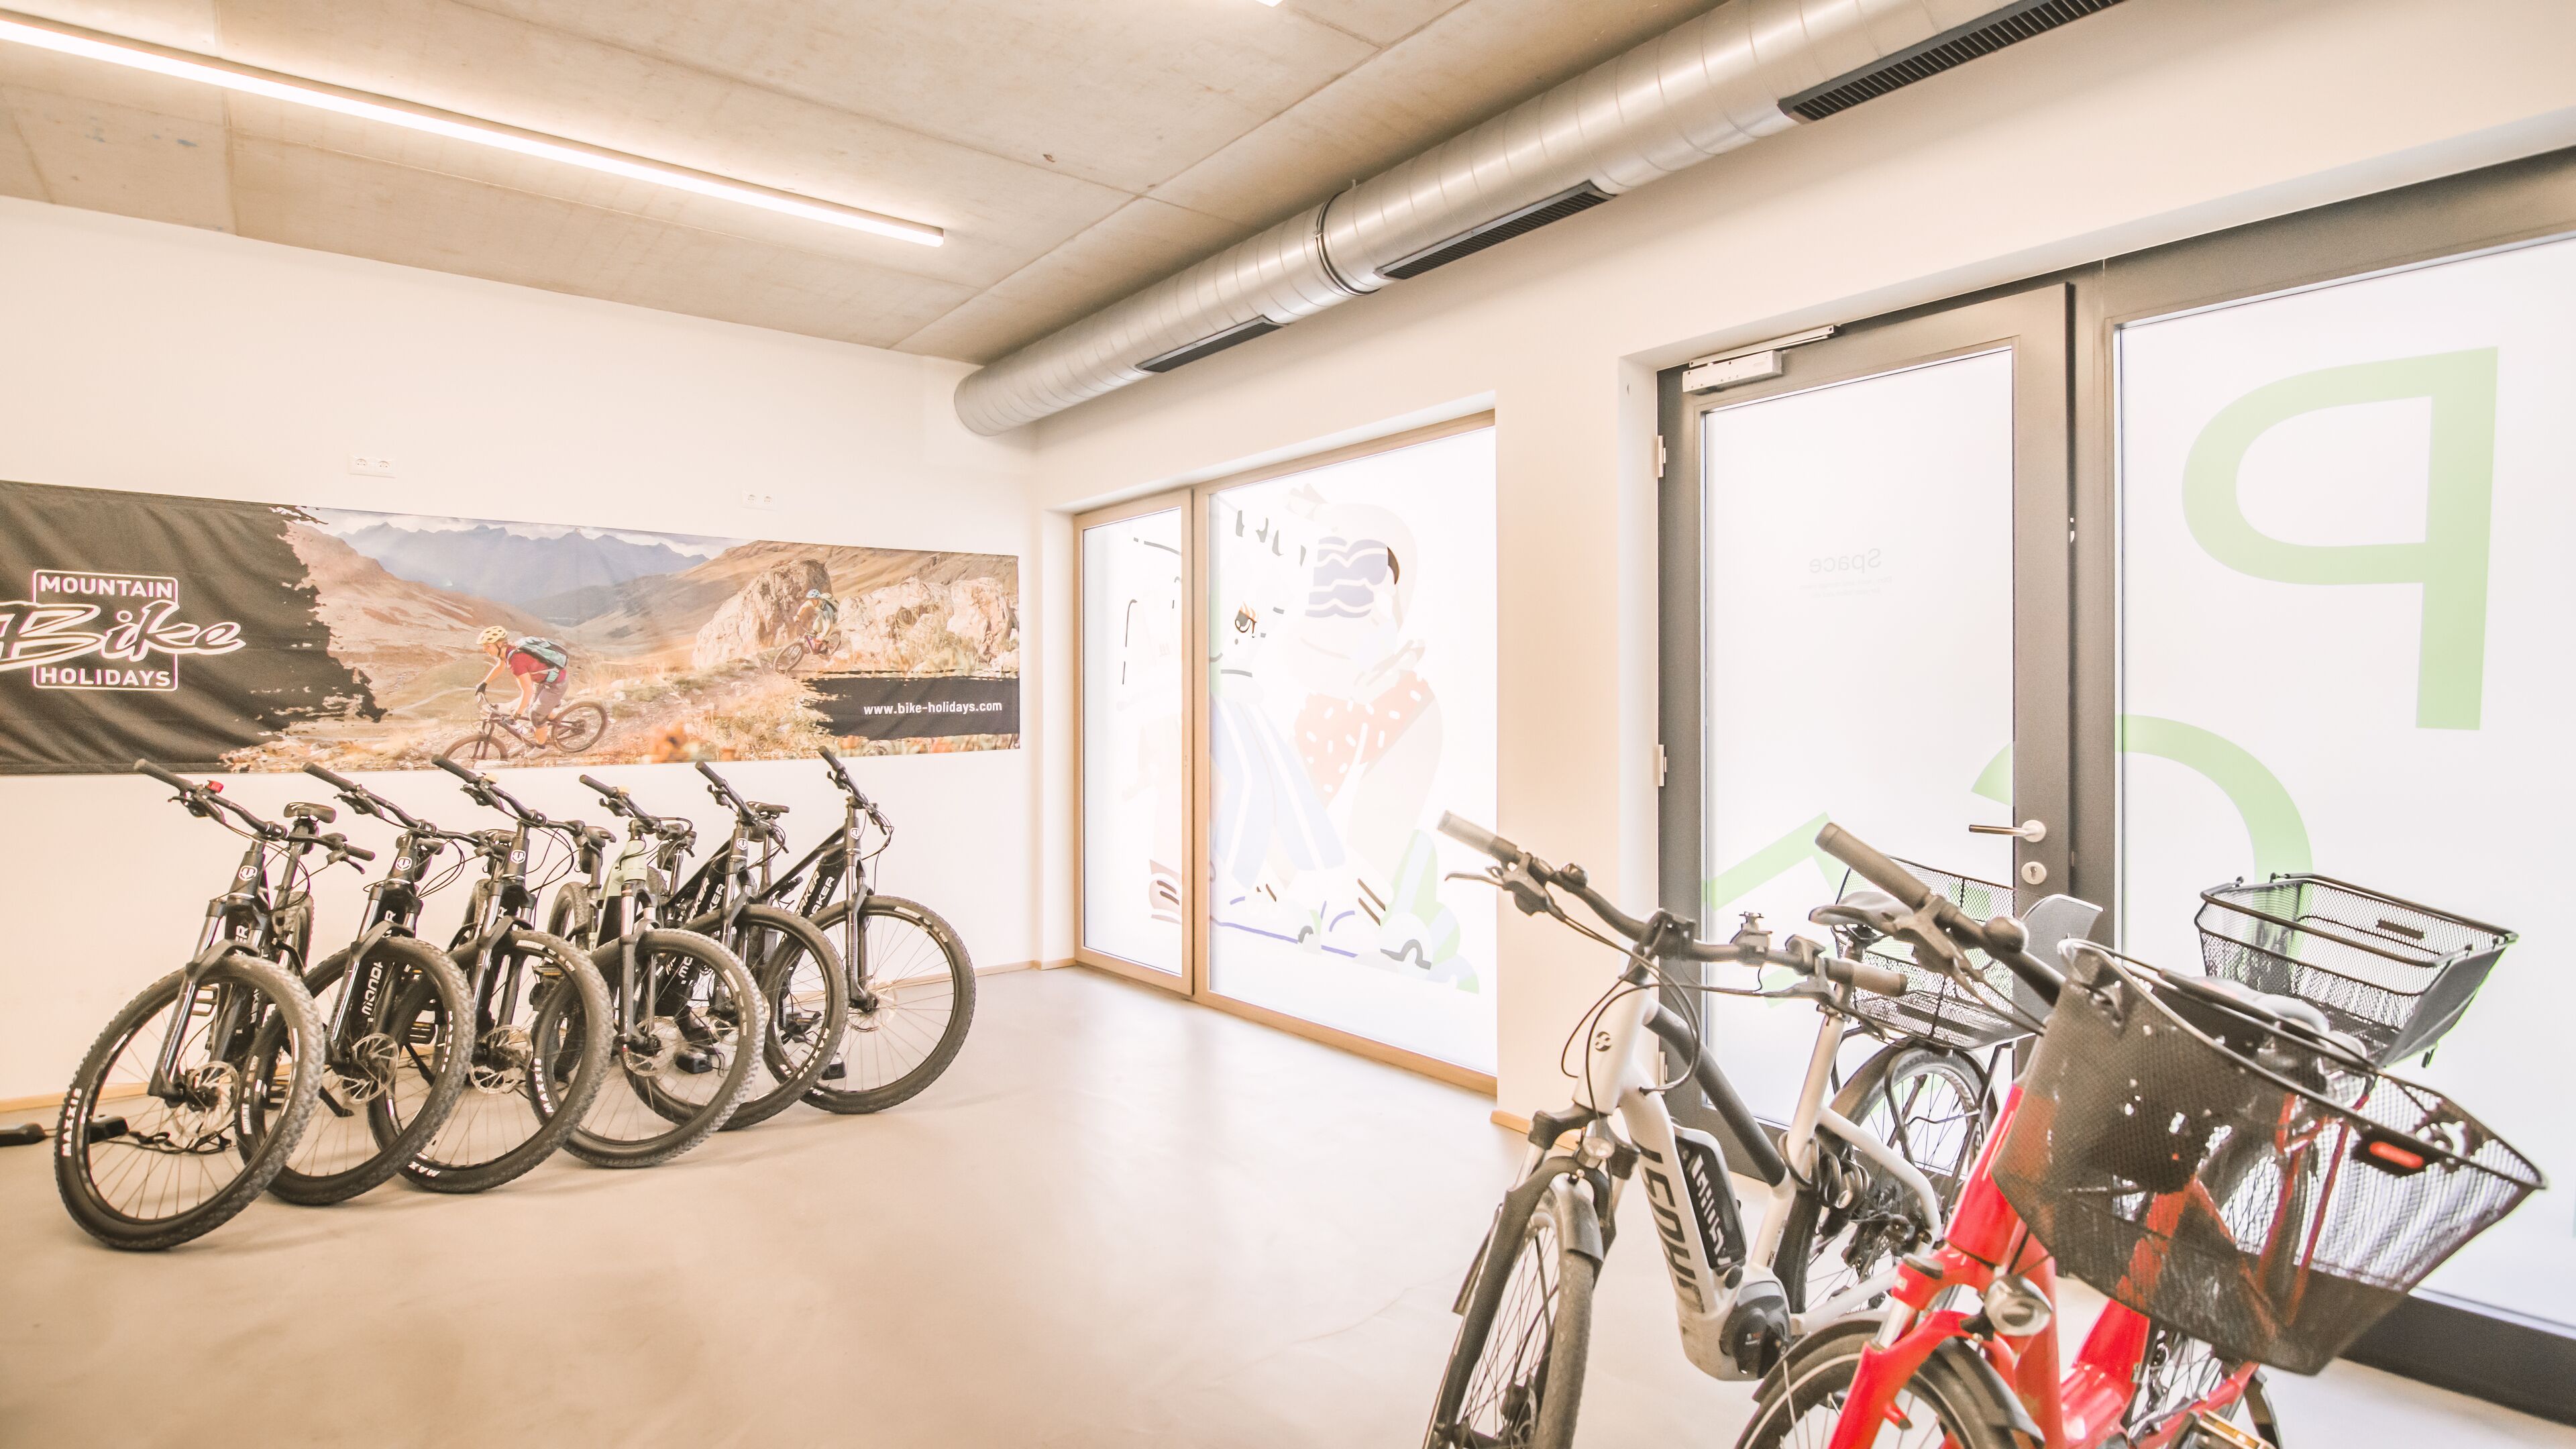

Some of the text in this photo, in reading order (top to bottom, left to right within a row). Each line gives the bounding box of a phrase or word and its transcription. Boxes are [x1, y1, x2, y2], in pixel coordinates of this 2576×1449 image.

[40, 575, 173, 598] MOUNTAIN
[0, 599, 247, 671] Bike
[40, 666, 171, 687] HOLIDAYS
[863, 701, 1003, 716] www.bike-holidays.com
[534, 1058, 555, 1113] MAXXIS
[62, 1087, 83, 1157] MAXXIS
